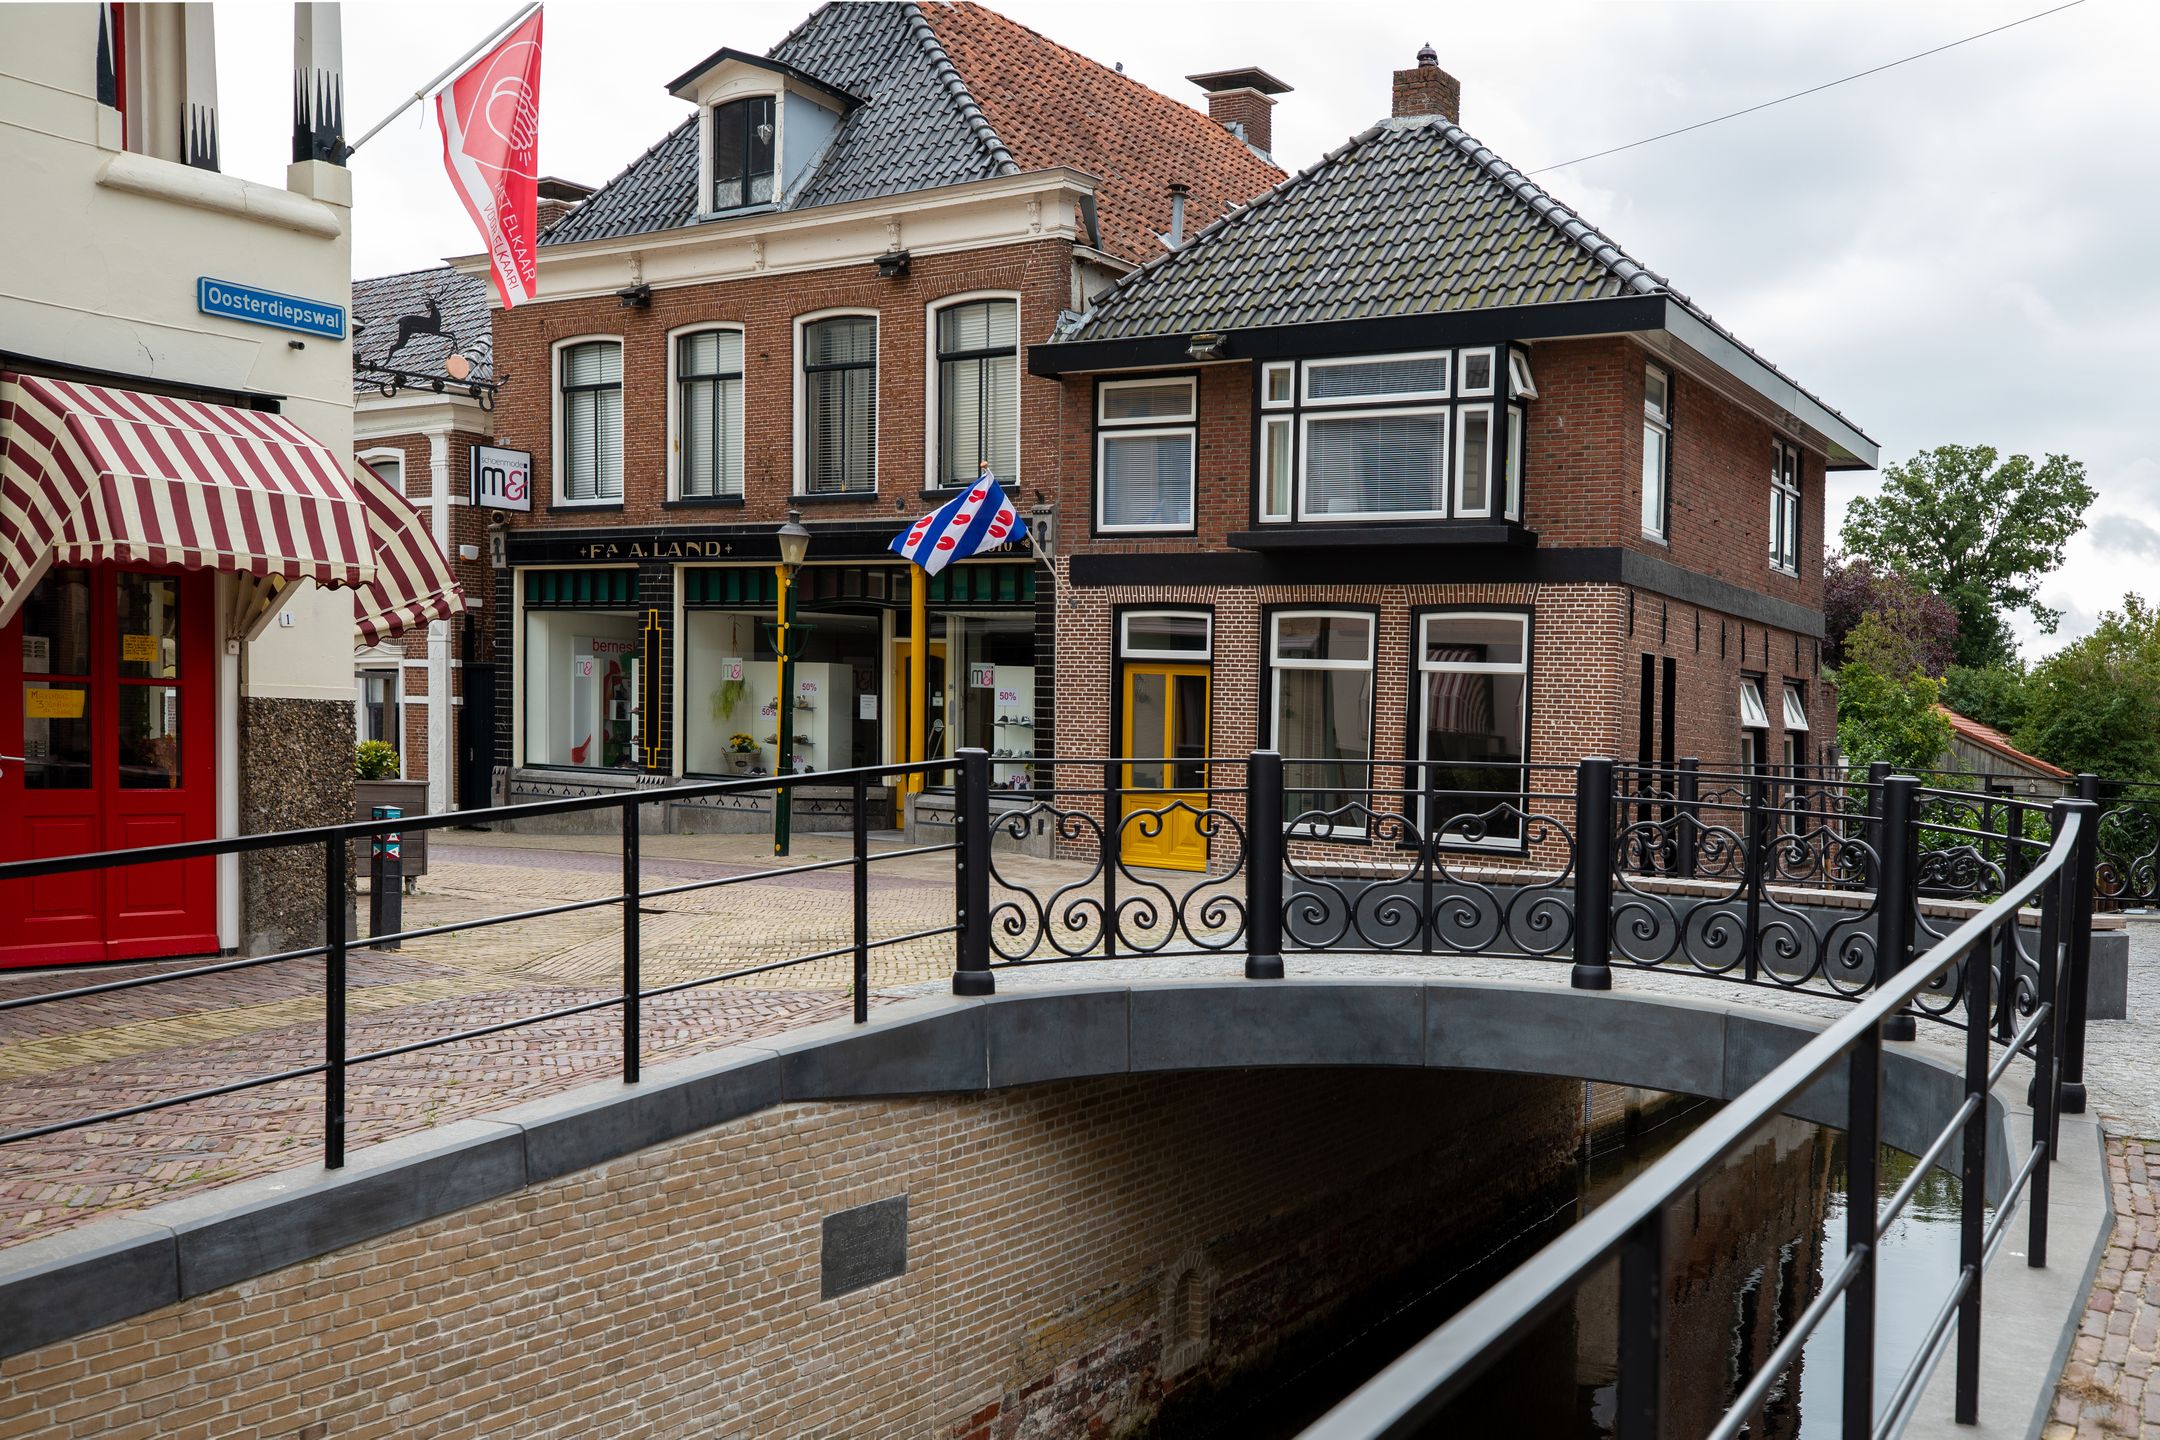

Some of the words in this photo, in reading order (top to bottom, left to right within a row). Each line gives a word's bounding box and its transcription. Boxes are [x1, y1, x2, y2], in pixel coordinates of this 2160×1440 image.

[503, 214, 536, 282] ELKAAR
[208, 287, 339, 329] Oosterdiepswal
[481, 456, 524, 469] schoenmode
[482, 463, 529, 501] m&i
[972, 666, 994, 688] m&i
[801, 682, 817, 692] 50%
[999, 691, 1017, 701] 50%
[761, 707, 777, 717] 50%
[791, 755, 804, 763] 0%
